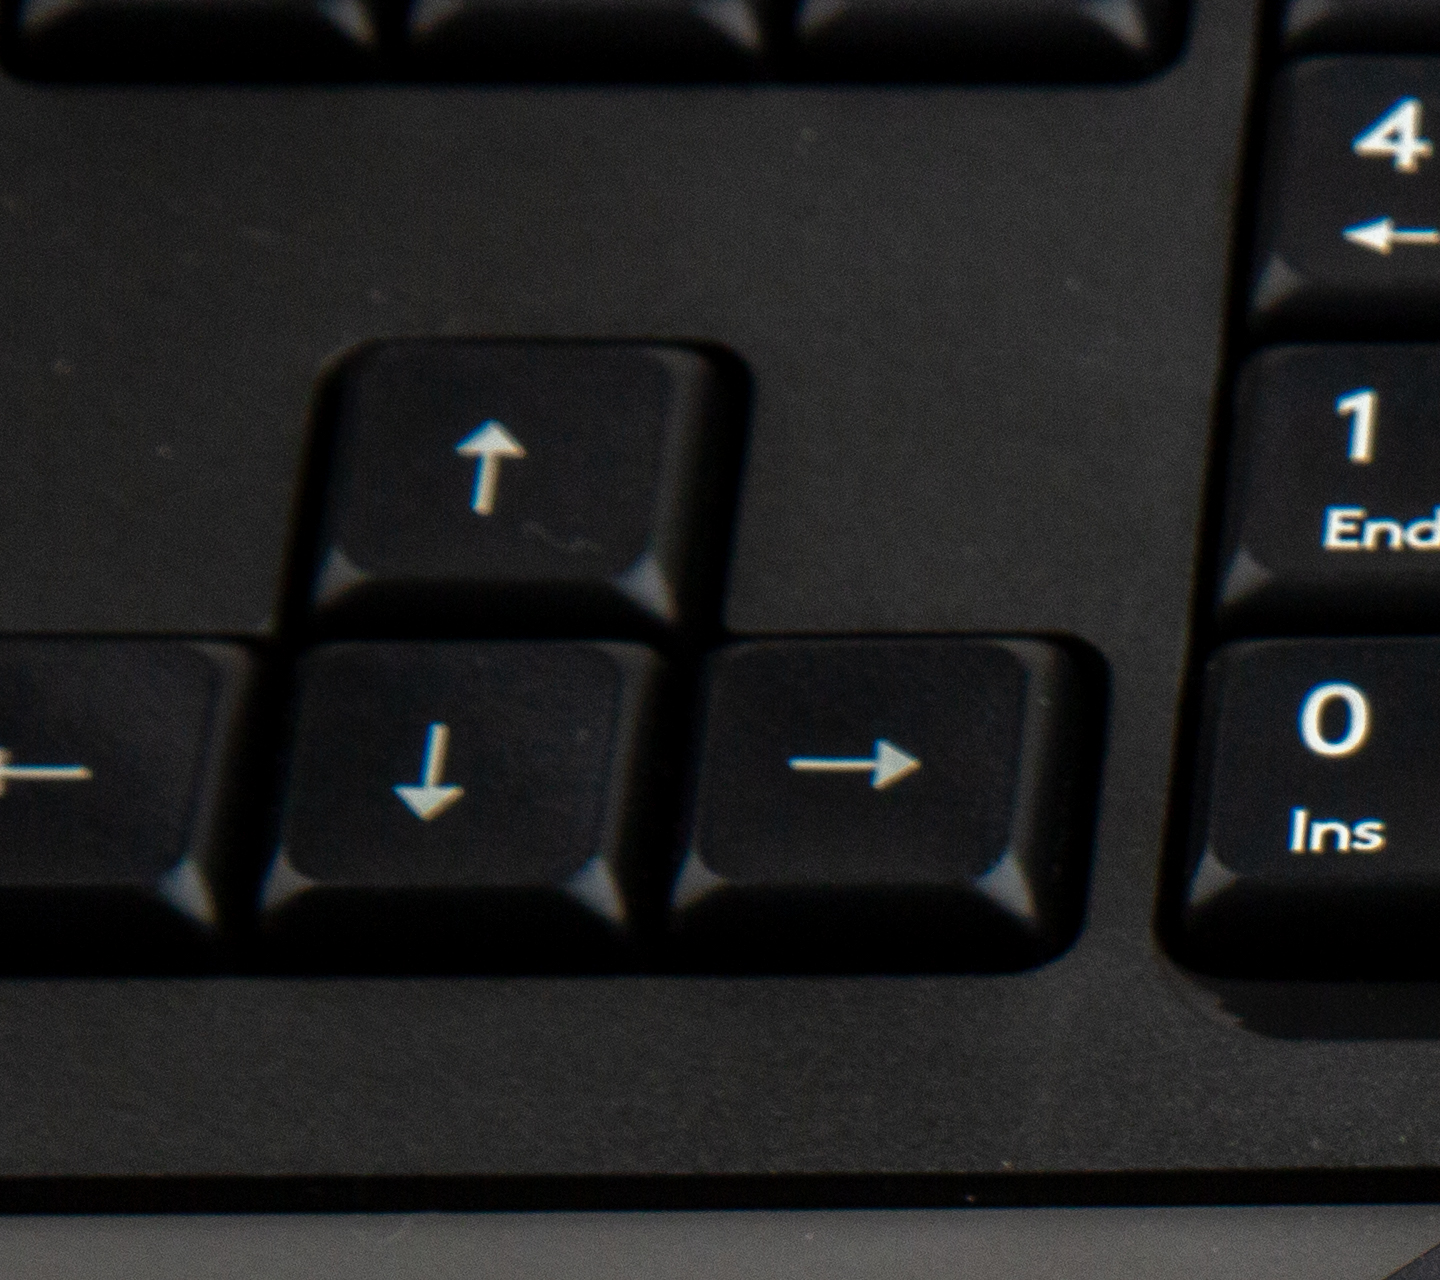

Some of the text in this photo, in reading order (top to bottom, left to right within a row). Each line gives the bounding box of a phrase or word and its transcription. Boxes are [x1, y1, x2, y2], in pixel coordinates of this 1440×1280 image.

[1356, 101, 1428, 169] 4
[1338, 391, 1374, 461] 1
[1301, 684, 1369, 756] 0
[1291, 809, 1383, 852] Ins
